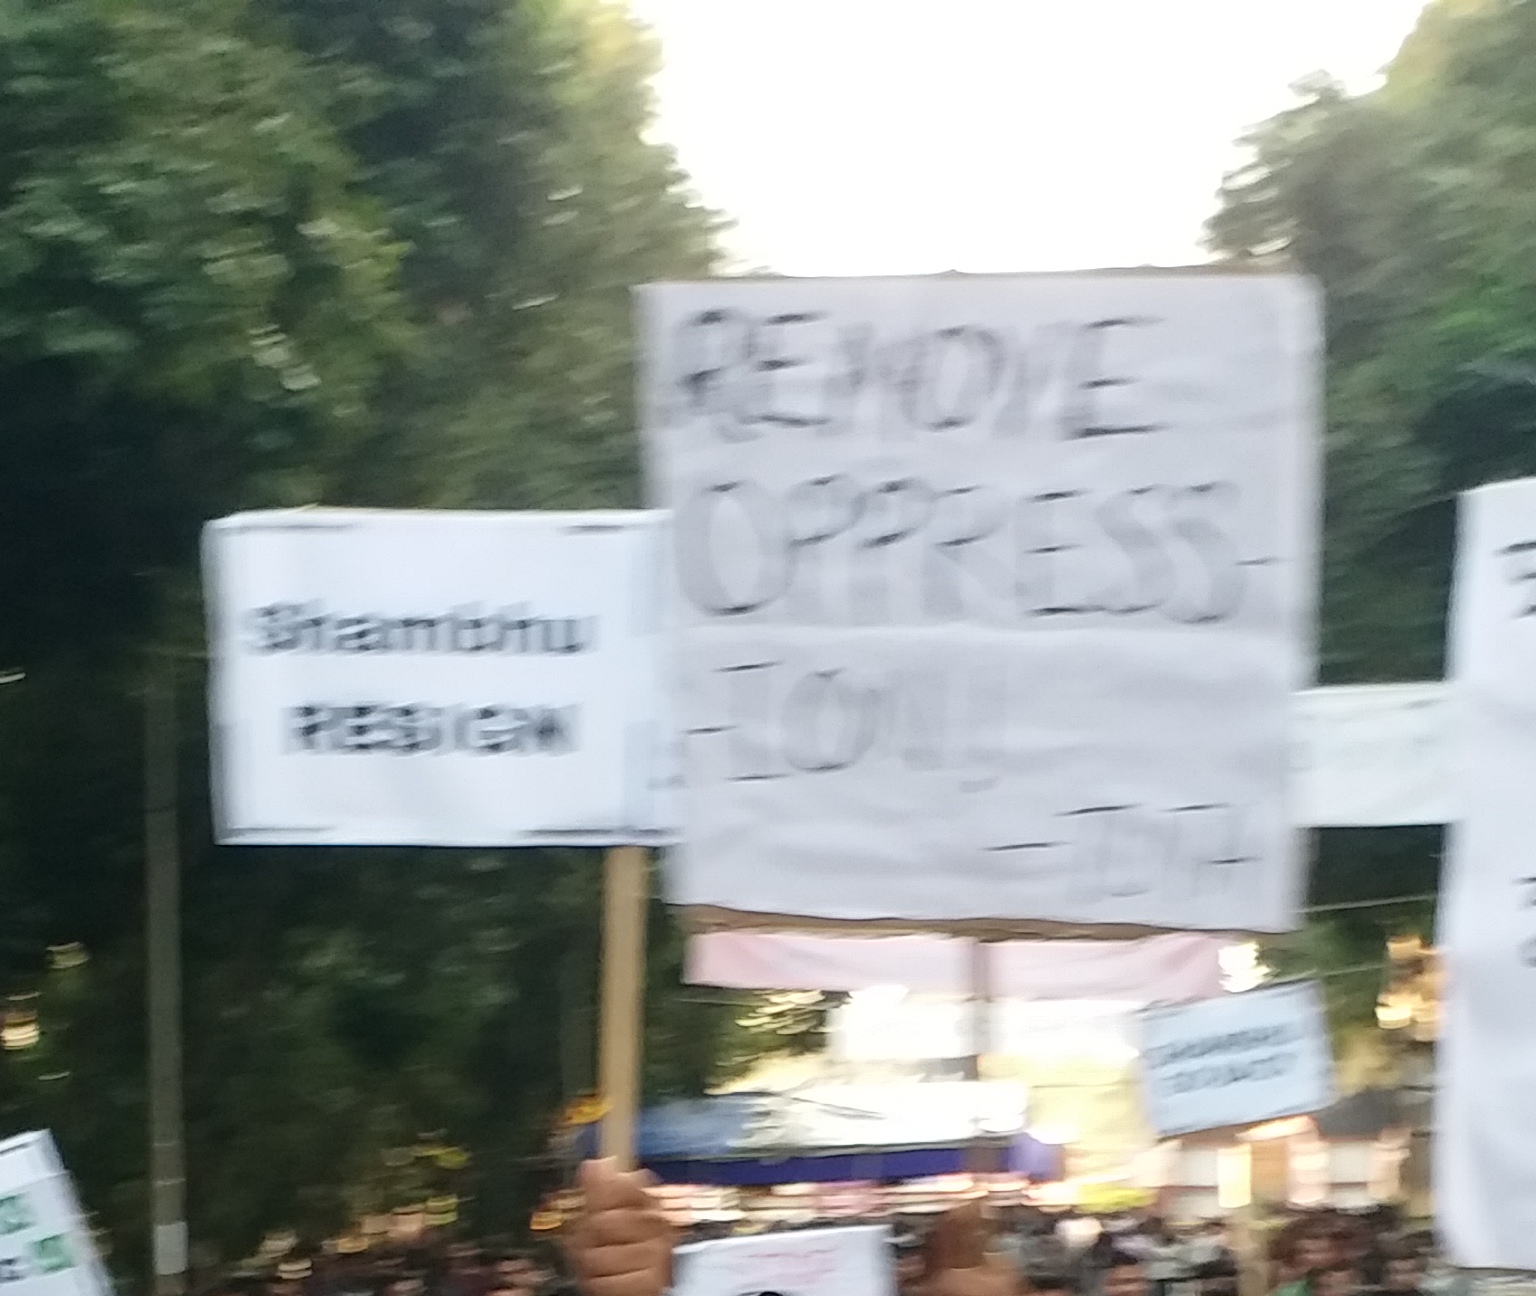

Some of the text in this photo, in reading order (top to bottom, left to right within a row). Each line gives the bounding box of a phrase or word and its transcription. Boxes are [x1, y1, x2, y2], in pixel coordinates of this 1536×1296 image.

[668, 304, 1172, 444] REMOVE
[247, 598, 602, 656] Shambhu
[280, 702, 580, 756] RESIGN
